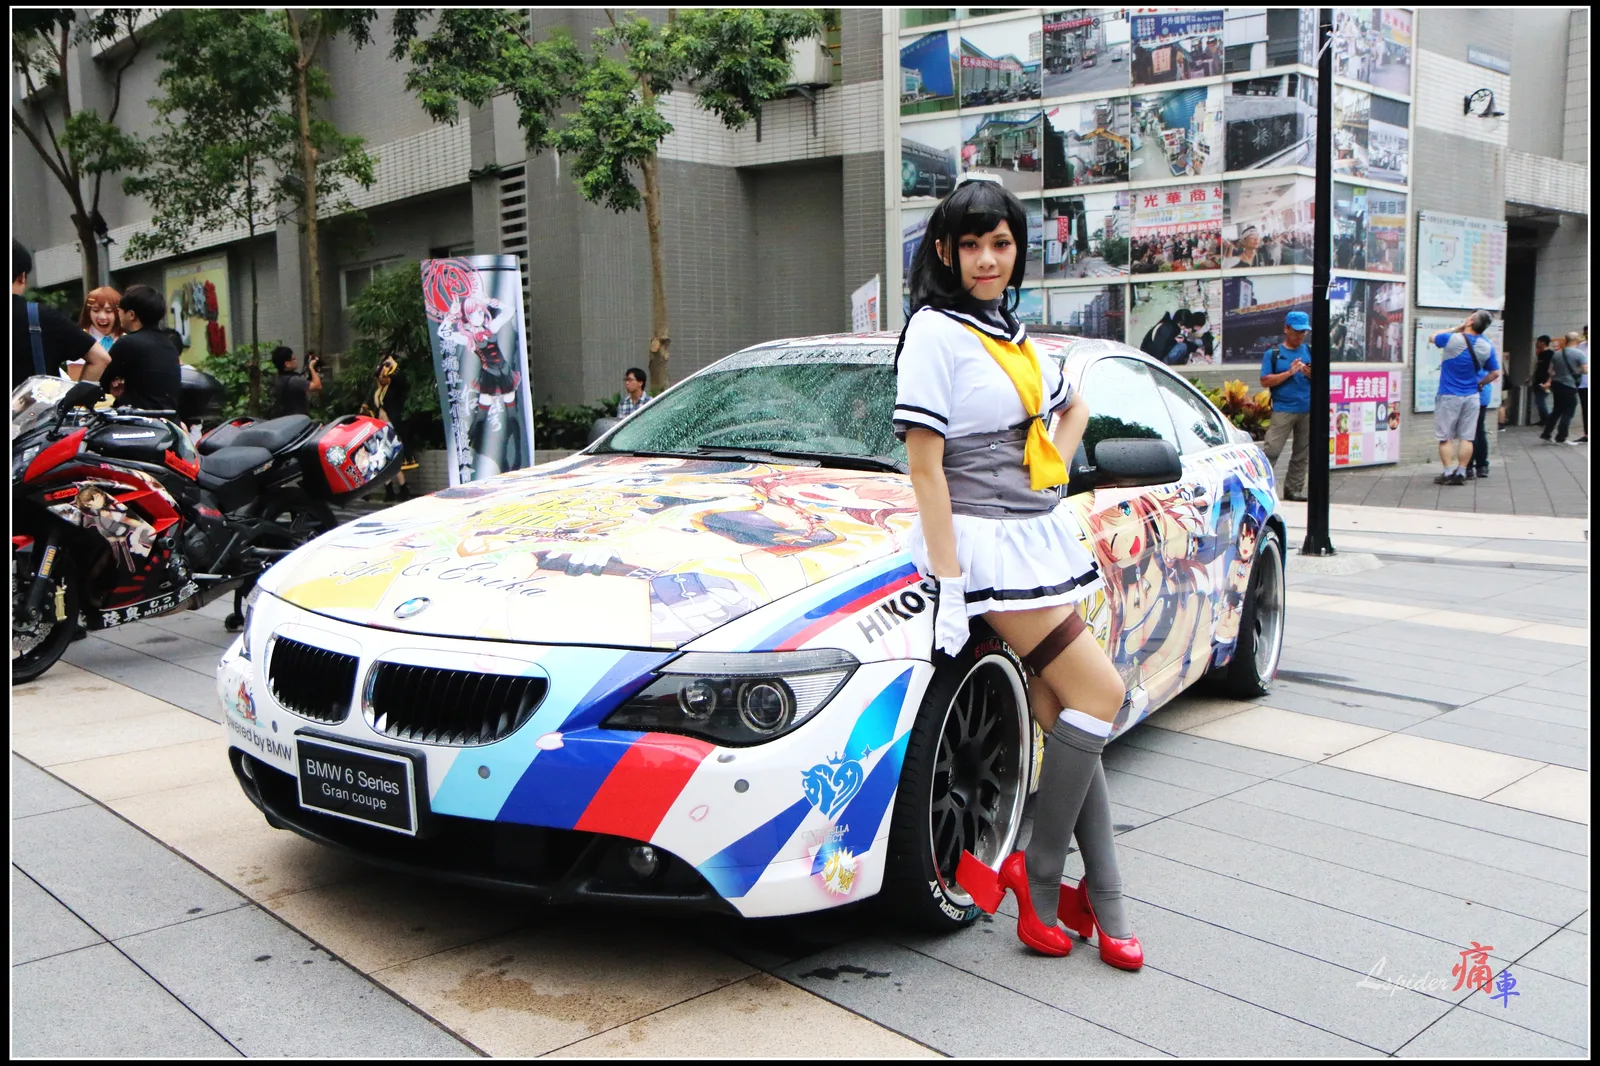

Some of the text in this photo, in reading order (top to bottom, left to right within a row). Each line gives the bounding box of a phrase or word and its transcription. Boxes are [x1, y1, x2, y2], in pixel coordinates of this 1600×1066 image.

[144, 601, 175, 617] MUTSU
[253, 730, 265, 752] by
[265, 737, 292, 762] BMW
[306, 759, 400, 796] BMW 6 Series
[321, 783, 387, 810] Gran coupe
